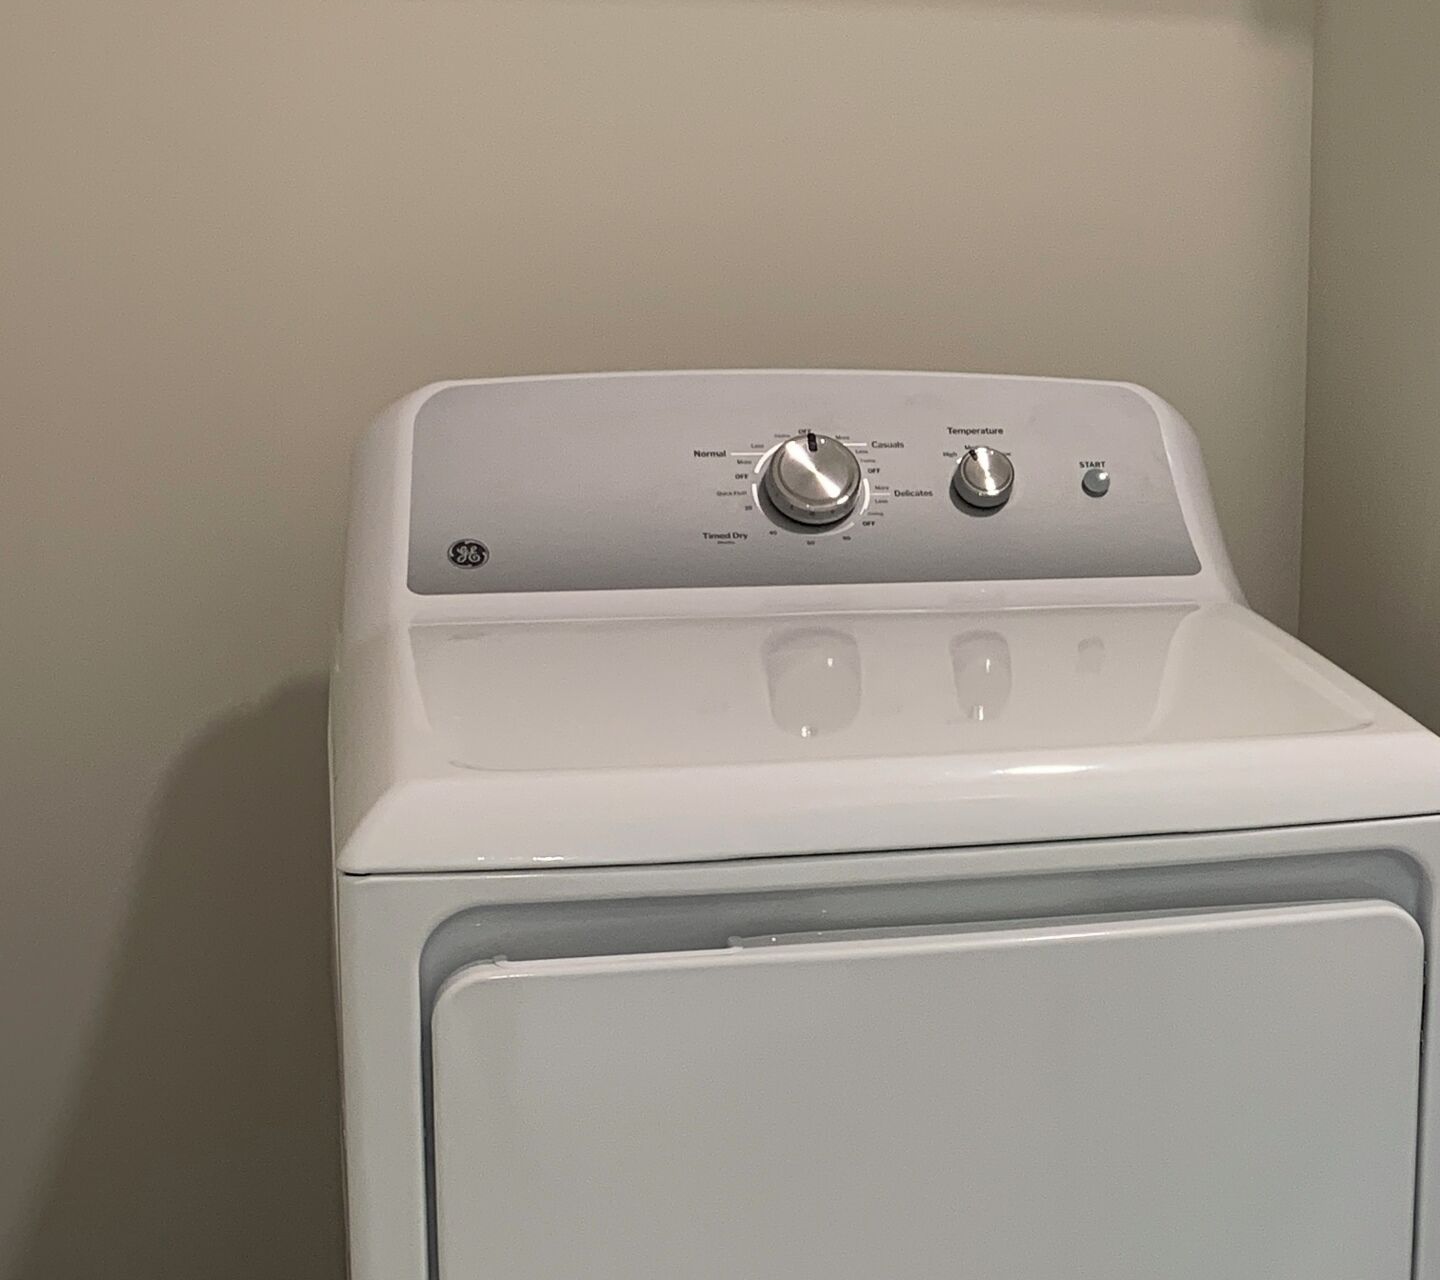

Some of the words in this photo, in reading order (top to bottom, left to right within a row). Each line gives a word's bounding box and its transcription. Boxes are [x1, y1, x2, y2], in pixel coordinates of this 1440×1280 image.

[946, 426, 1004, 436] Temperature
[871, 440, 905, 449] Casuals
[693, 449, 727, 458] Normal
[702, 532, 731, 540] Timed
[733, 531, 748, 541] Dry
